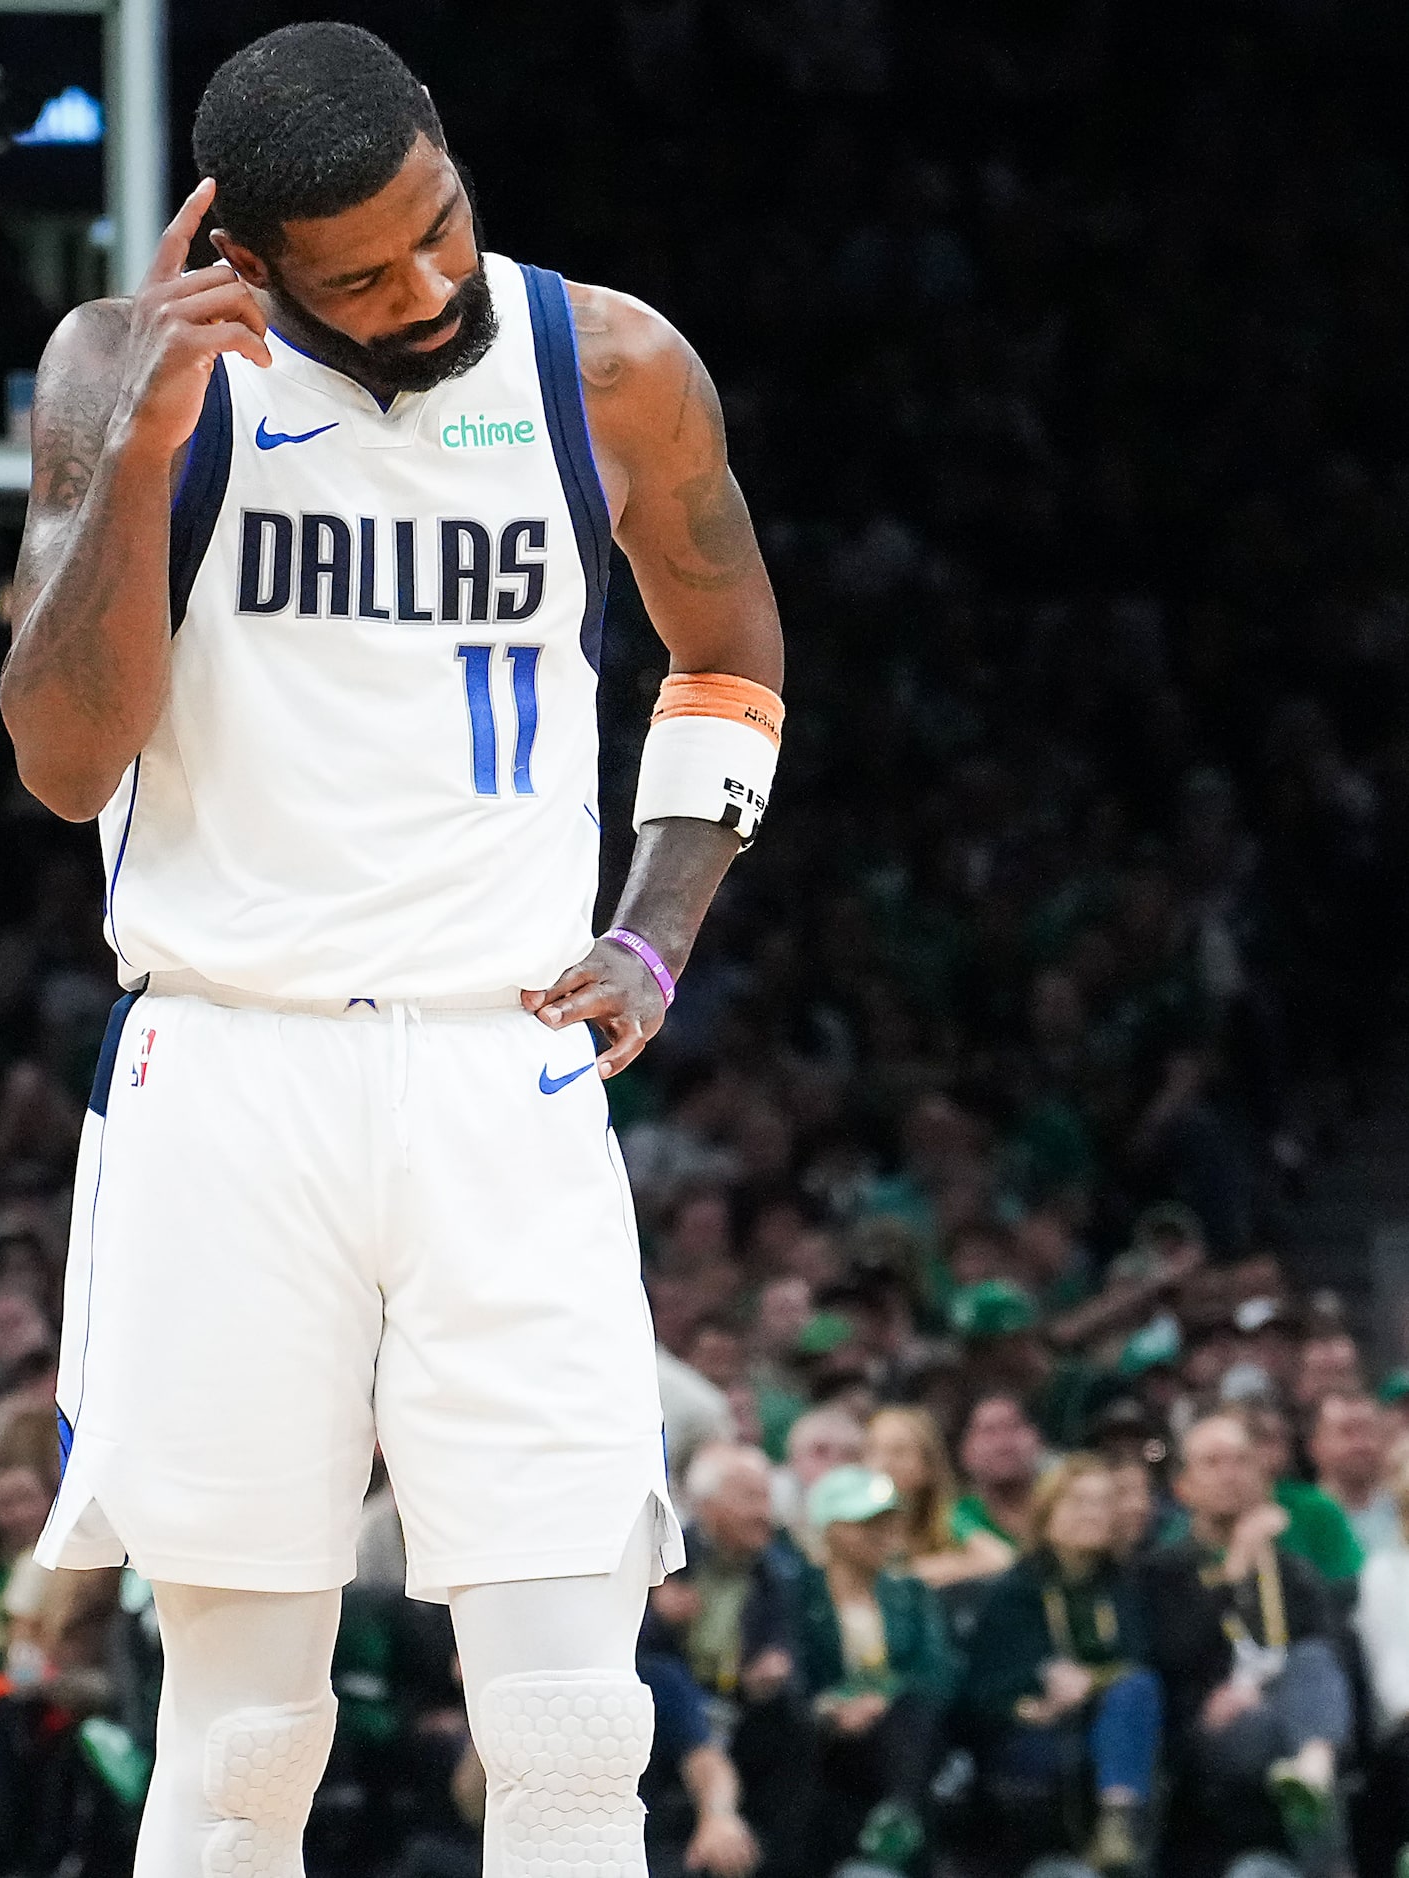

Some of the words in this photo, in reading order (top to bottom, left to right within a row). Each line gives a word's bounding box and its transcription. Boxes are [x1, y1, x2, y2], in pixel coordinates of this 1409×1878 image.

[442, 414, 535, 448] chime
[234, 507, 549, 625] DALLAS
[453, 642, 546, 800] 11
